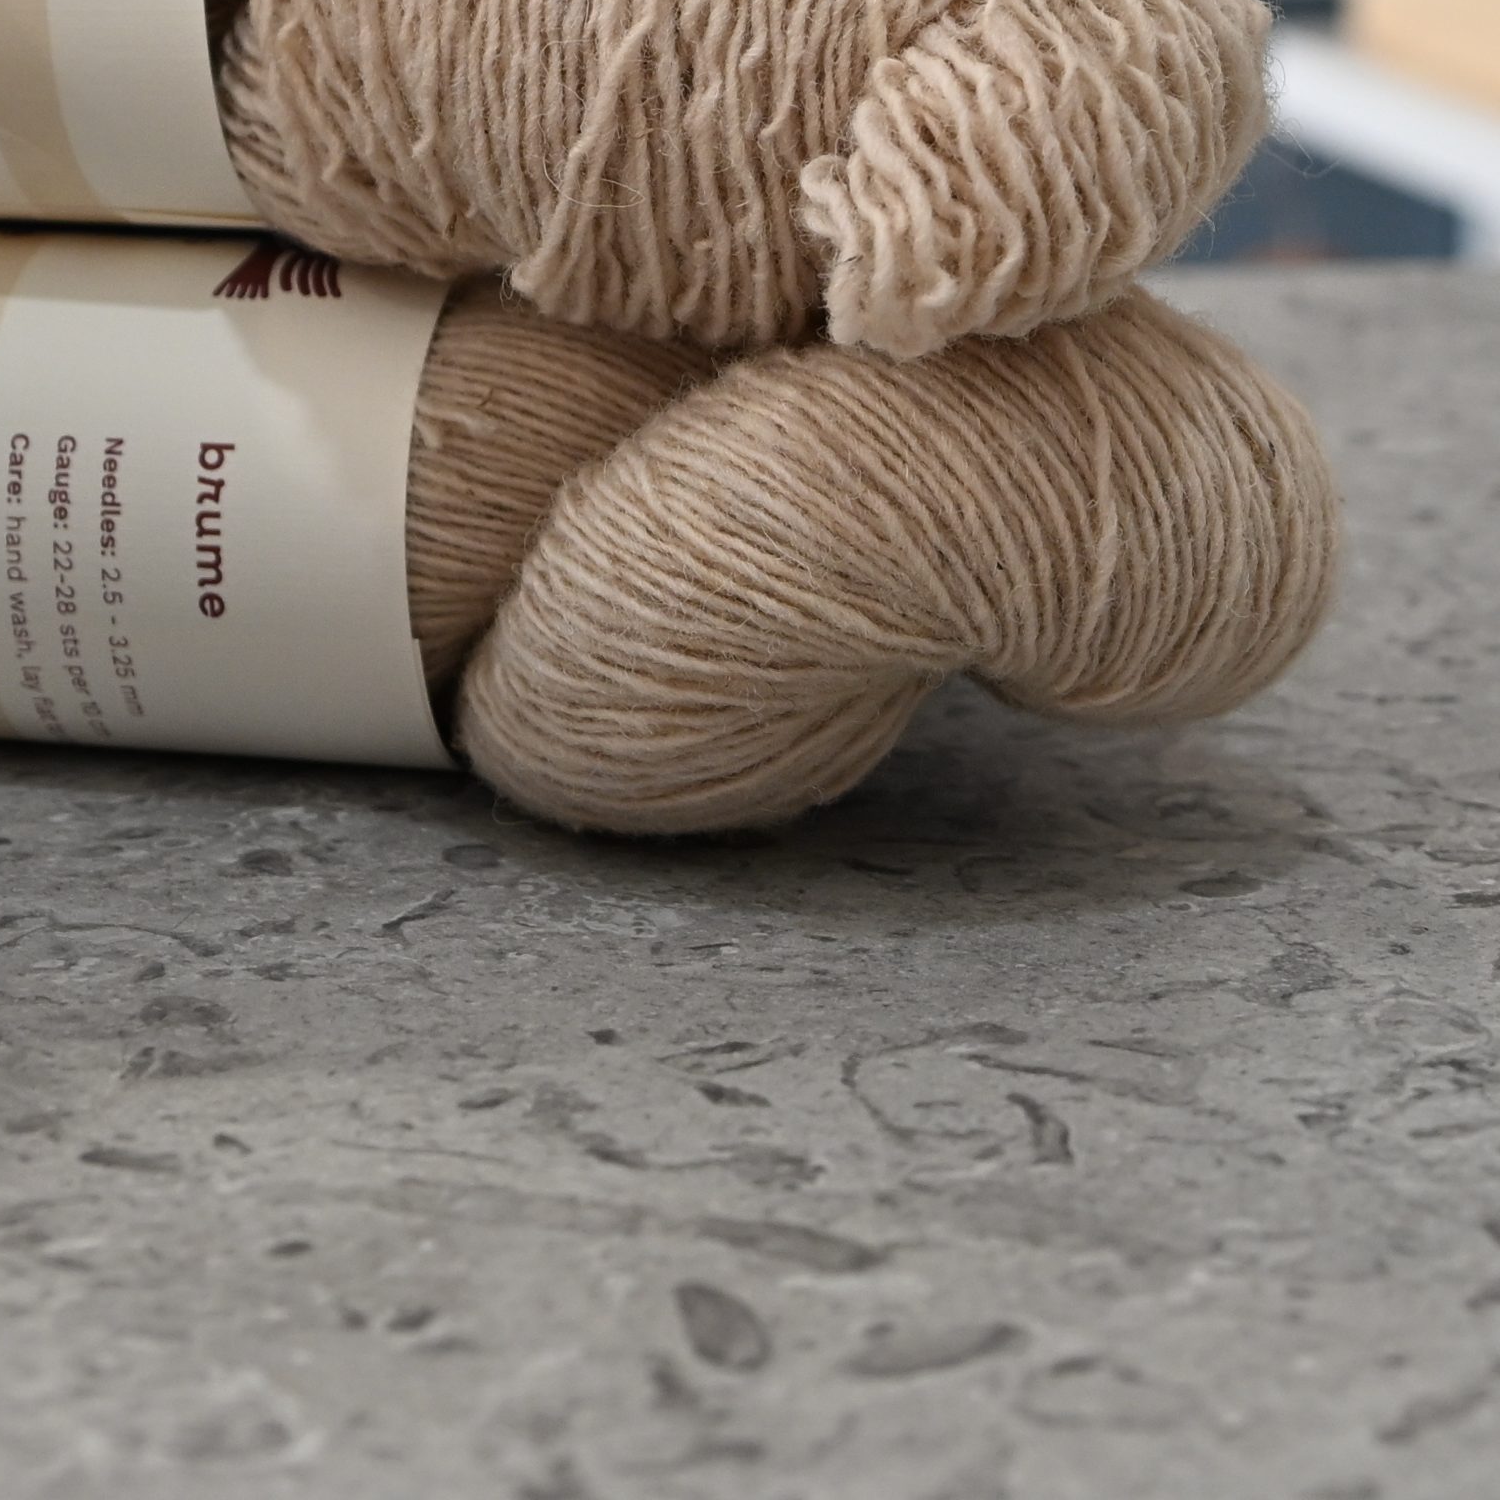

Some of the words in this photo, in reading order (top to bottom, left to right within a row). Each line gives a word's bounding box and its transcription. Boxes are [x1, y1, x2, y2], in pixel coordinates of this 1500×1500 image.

[7, 433, 31, 504] Care:
[48, 435, 78, 530] Gauge:
[100, 437, 125, 557] Needles:
[5, 516, 28, 582] hand
[195, 442, 236, 619] brume
[52, 540, 77, 616] 22-28
[101, 568, 124, 606] 2.5
[59, 623, 81, 658] sts
[108, 635, 136, 680] 3.25
[62, 664, 91, 697] per
